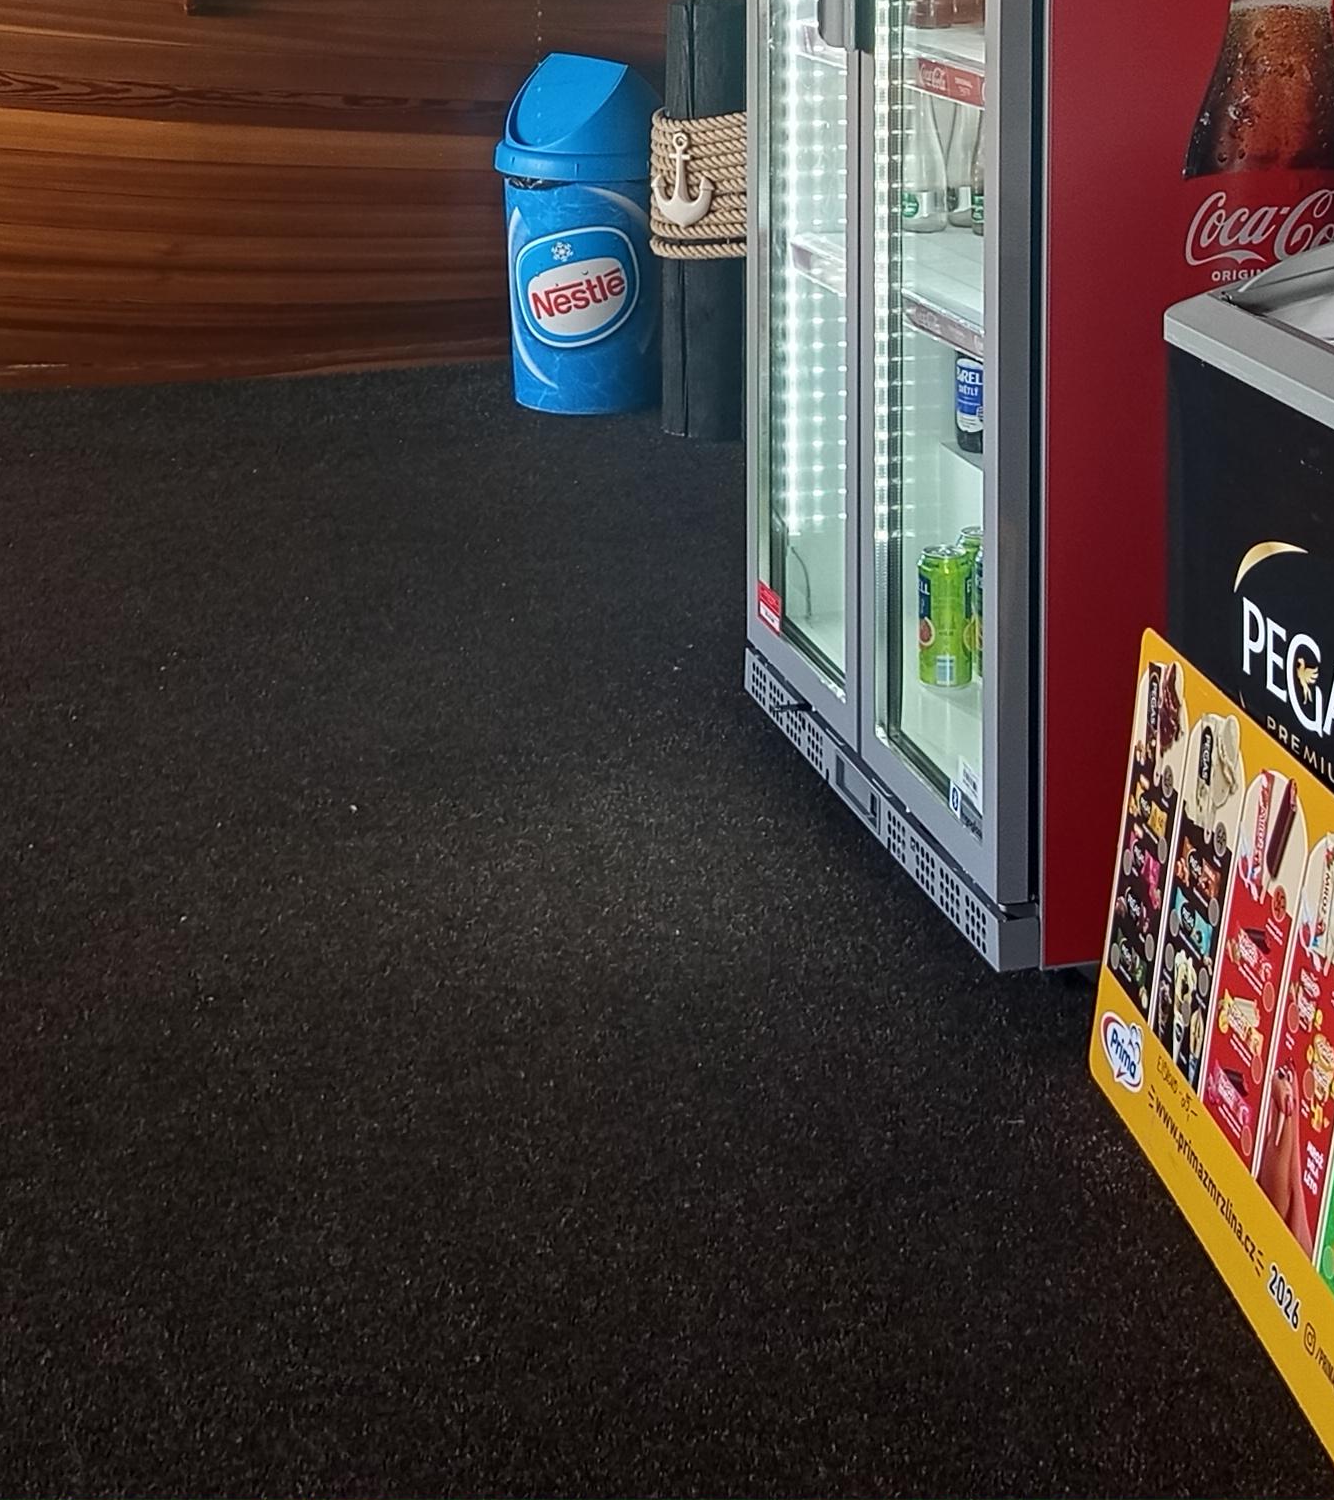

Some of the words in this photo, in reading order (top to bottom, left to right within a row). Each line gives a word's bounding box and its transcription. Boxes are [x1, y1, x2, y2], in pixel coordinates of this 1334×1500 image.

[531, 268, 627, 320] Nestlé
[1110, 1029, 1136, 1079] Prima
[1155, 1098, 1257, 1259] www.primazmrzlina.cz
[1268, 1265, 1302, 1330] 2026
